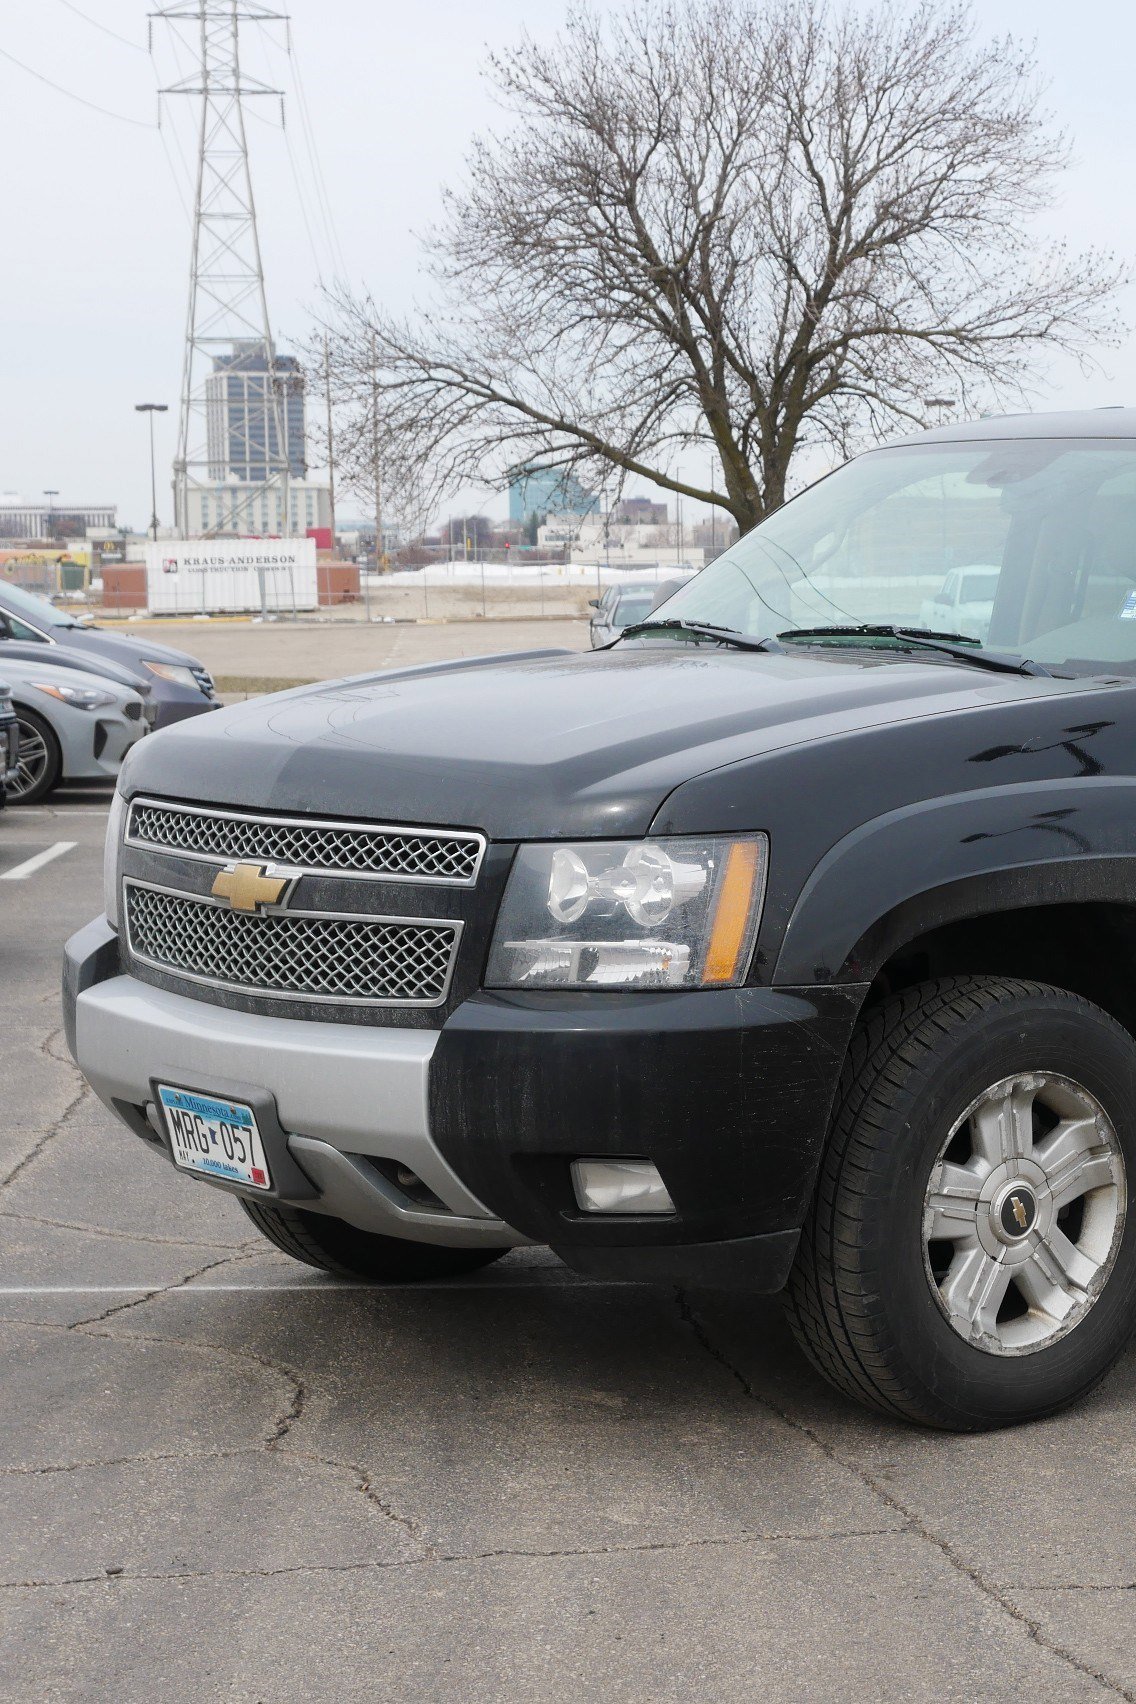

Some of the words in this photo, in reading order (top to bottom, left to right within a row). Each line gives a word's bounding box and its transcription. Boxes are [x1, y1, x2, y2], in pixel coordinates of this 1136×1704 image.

[184, 1096, 228, 1117] Minnesota
[169, 1108, 210, 1154] MRG
[220, 1121, 256, 1167] 057
[222, 1162, 239, 1174] lakes
